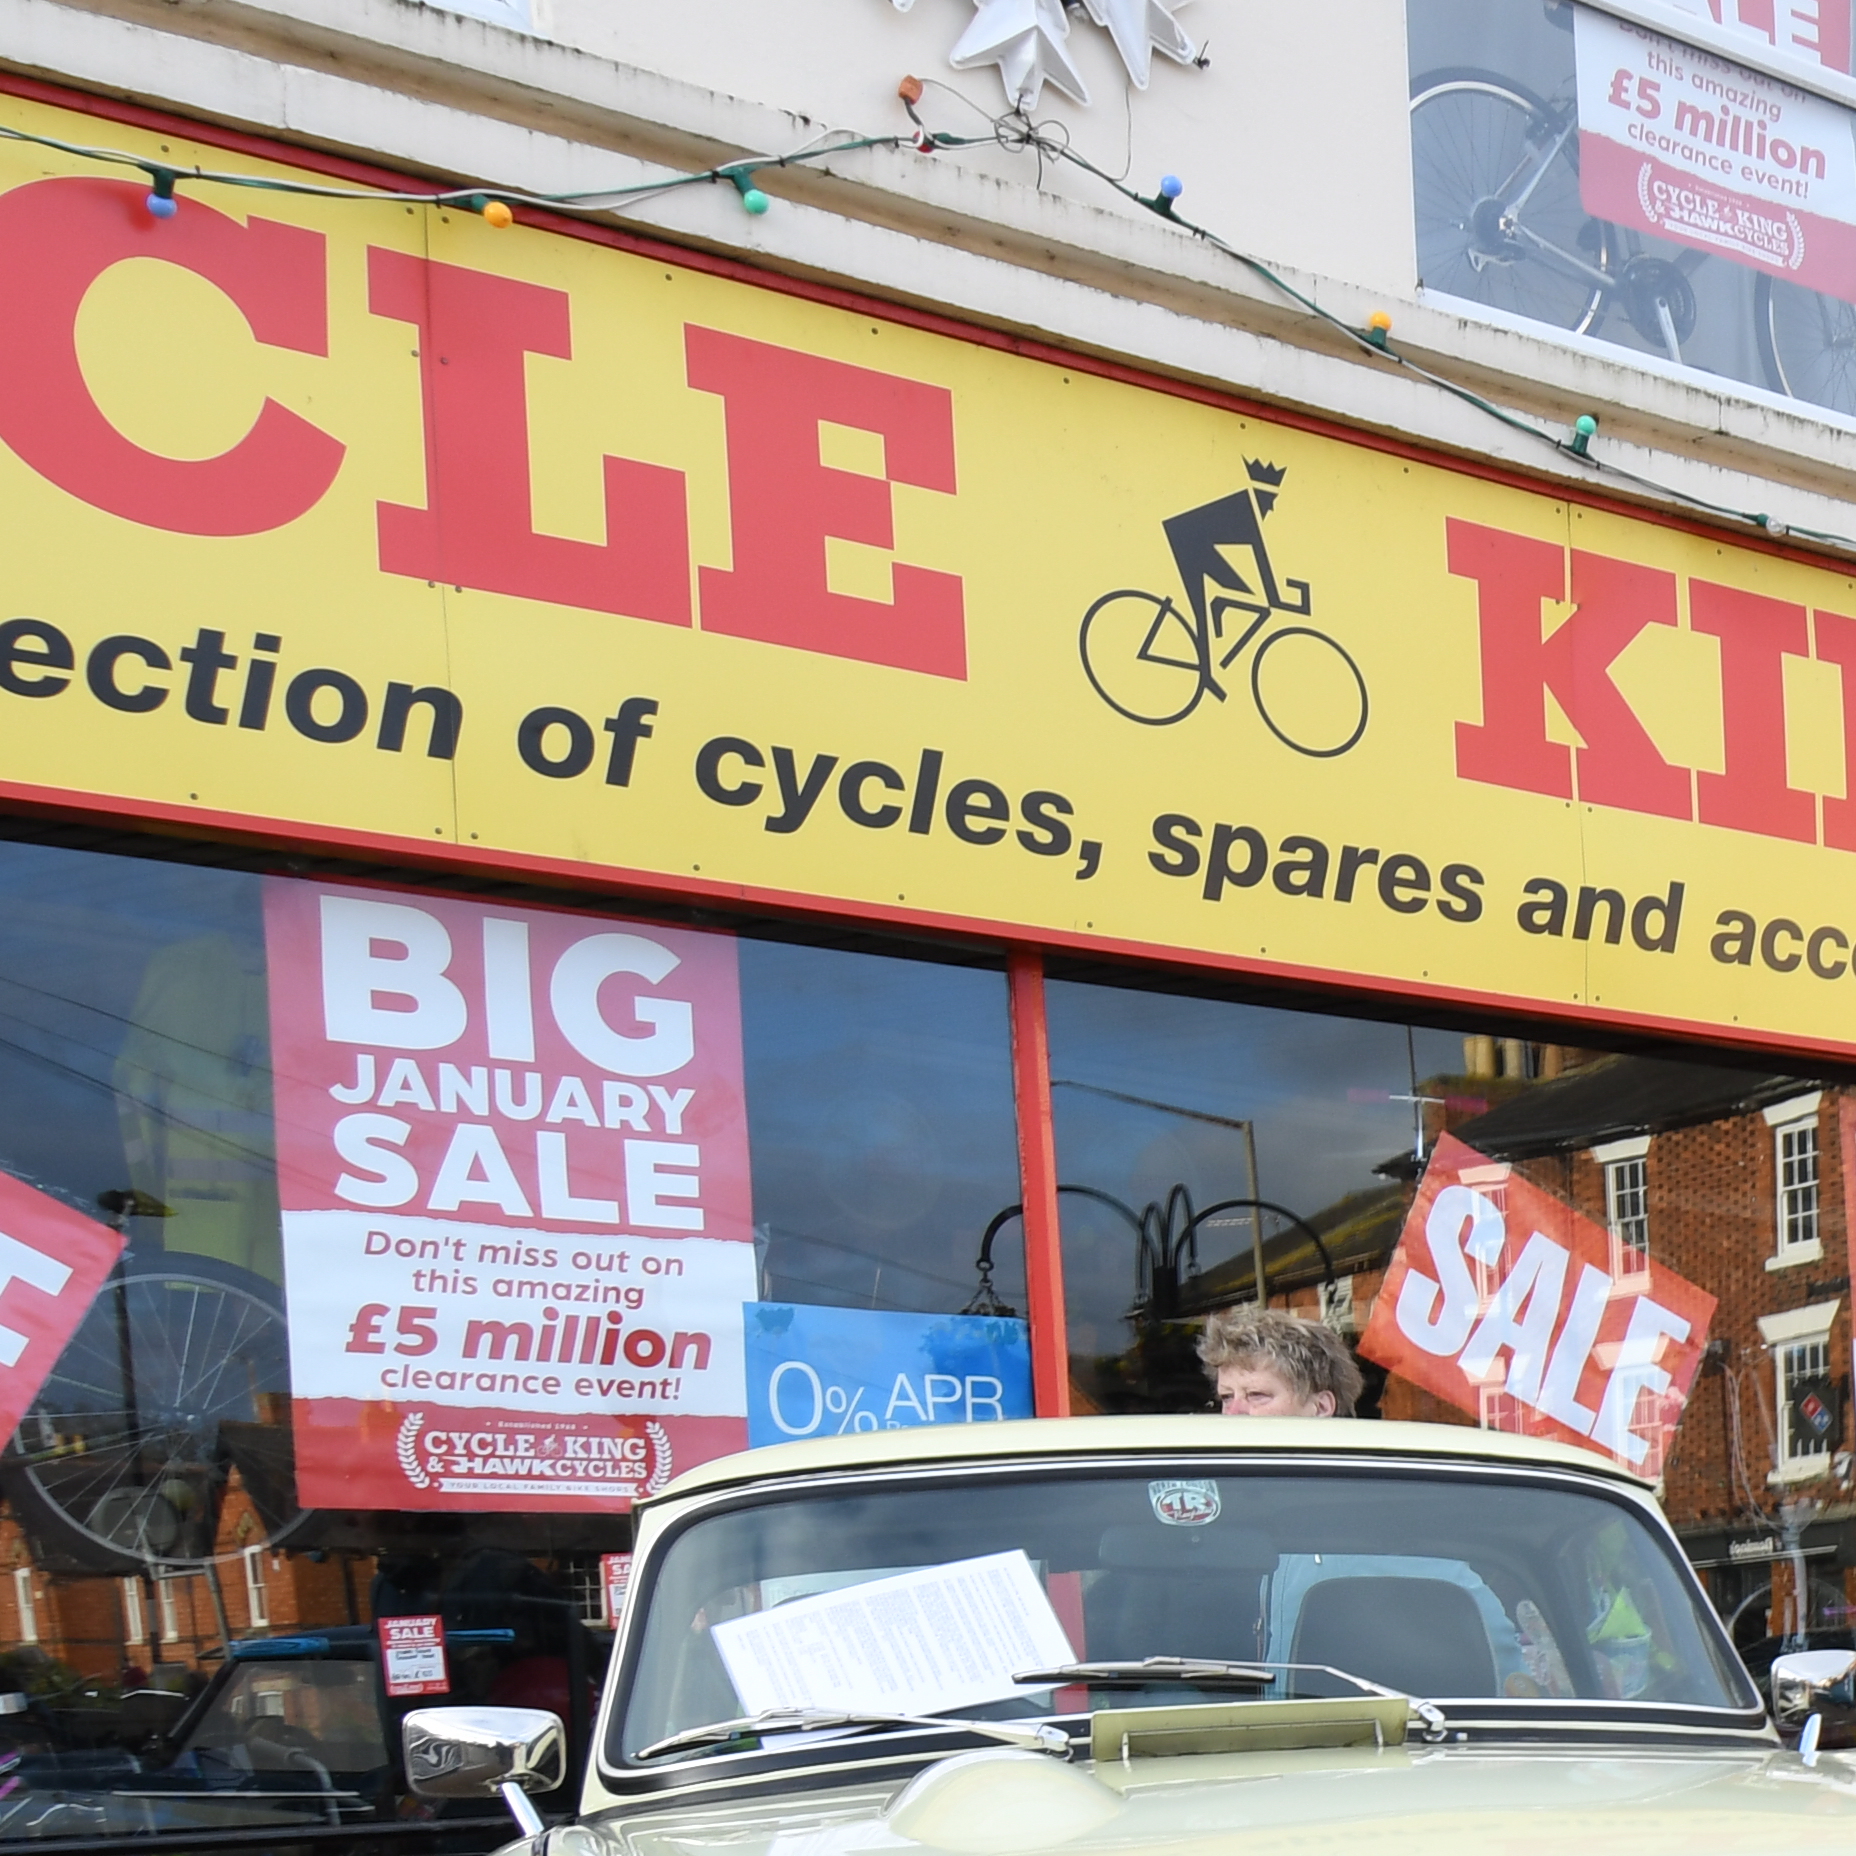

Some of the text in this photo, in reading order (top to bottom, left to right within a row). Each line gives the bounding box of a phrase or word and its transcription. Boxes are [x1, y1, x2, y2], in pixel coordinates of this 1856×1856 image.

[1647, 50, 1783, 123] this amazing
[1608, 68, 1826, 180] £5 million
[1628, 121, 1733, 175] clearance
[1741, 165, 1809, 199] event!
[1653, 179, 1719, 217] CYCLE
[1736, 205, 1788, 240] KING
[0, 616, 464, 761] ection
[517, 697, 659, 788] of
[694, 734, 1104, 881] cycles,
[1147, 811, 1486, 924] spares
[1516, 872, 1685, 956] and
[320, 894, 695, 1077] BIG
[328, 1053, 696, 1135] JANUARY
[332, 1112, 705, 1231] SALE
[363, 1230, 685, 1278] Don't miss out on
[411, 1266, 646, 1310] this amazing
[344, 1303, 713, 1371] £5 million
[1397, 1185, 1691, 1466] SALE
[380, 1362, 683, 1401] clearance event!
[768, 1361, 1005, 1436] 0% APR
[424, 1431, 647, 1460] CYCLE KING
[426, 1456, 445, 1473] &
[1161, 1491, 1207, 1510] TR
[390, 1626, 435, 1640] SALE
